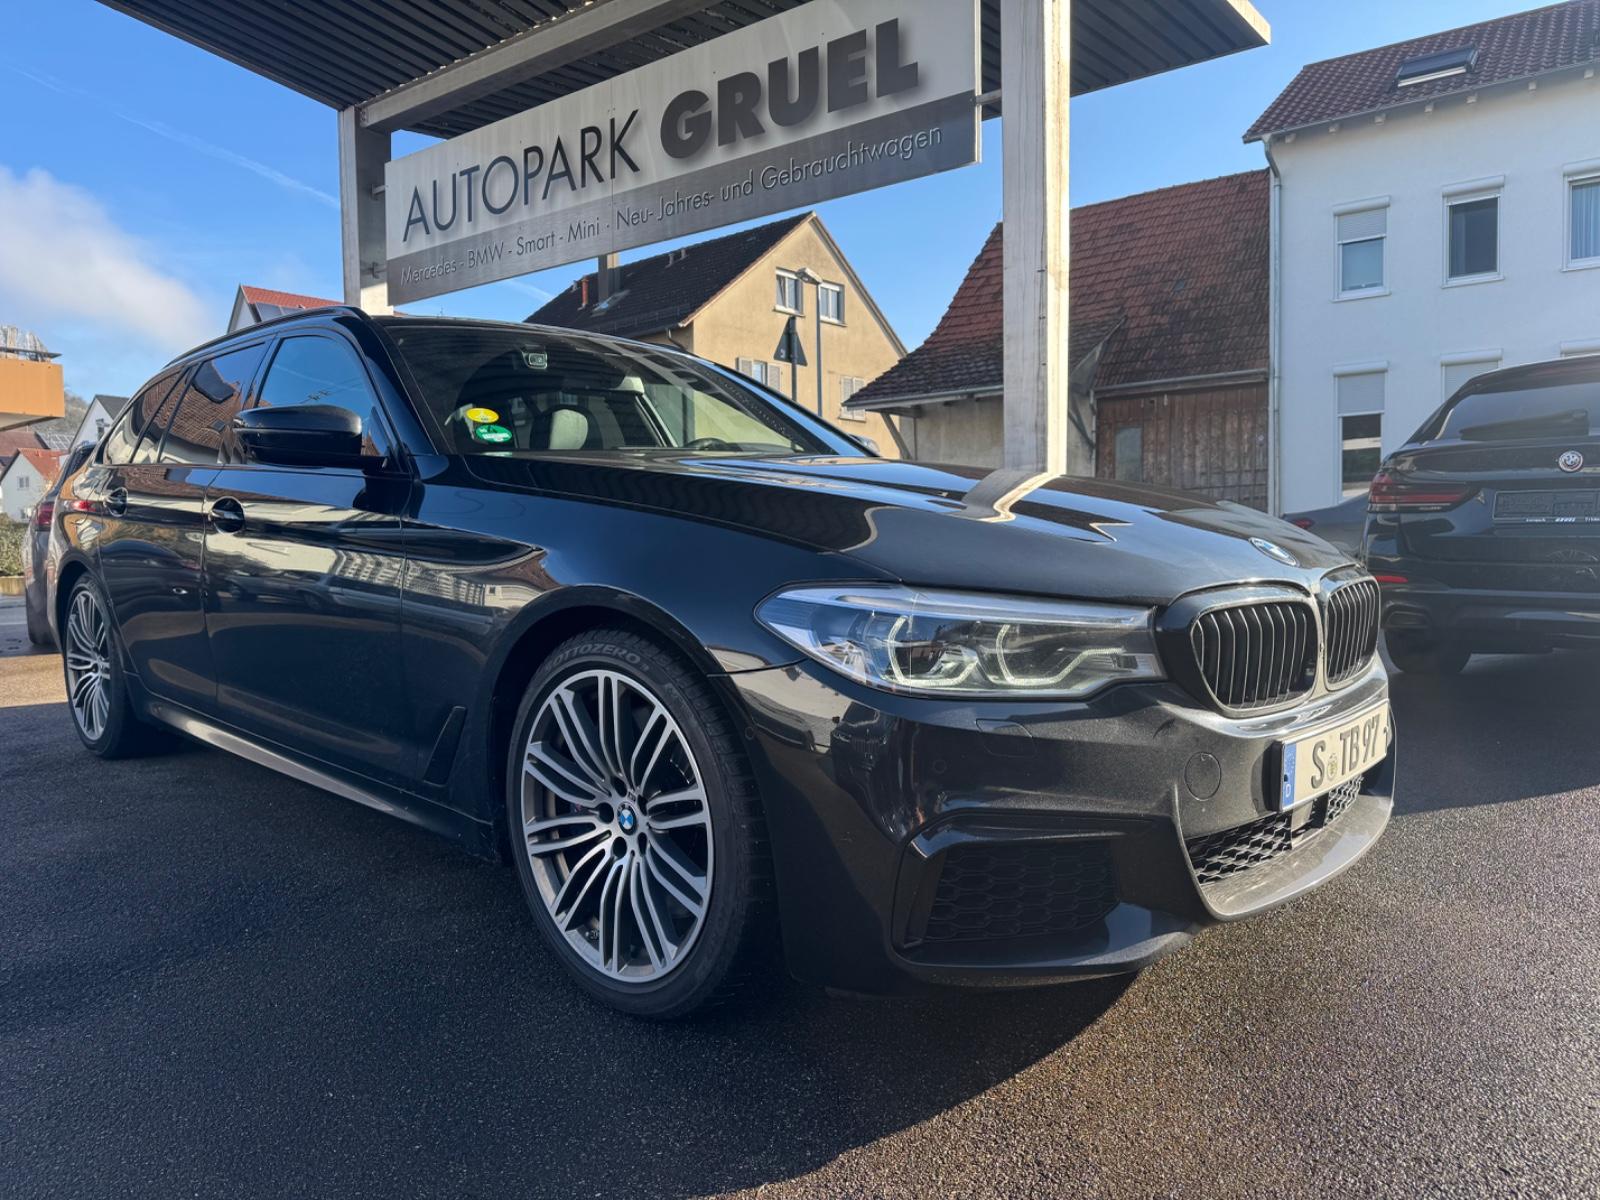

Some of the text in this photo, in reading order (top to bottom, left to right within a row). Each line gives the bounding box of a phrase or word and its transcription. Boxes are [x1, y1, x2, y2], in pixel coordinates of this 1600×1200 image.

[401, 256, 457, 287] Mercedes
[468, 242, 504, 269] BMW
[516, 231, 555, 256] Smart
[567, 216, 600, 243] Mini
[720, 168, 753, 202] und
[761, 127, 942, 190] Gebrauchtwagen
[402, 17, 919, 243] AUTOPARK GRUEL
[1310, 740, 1326, 789] S
